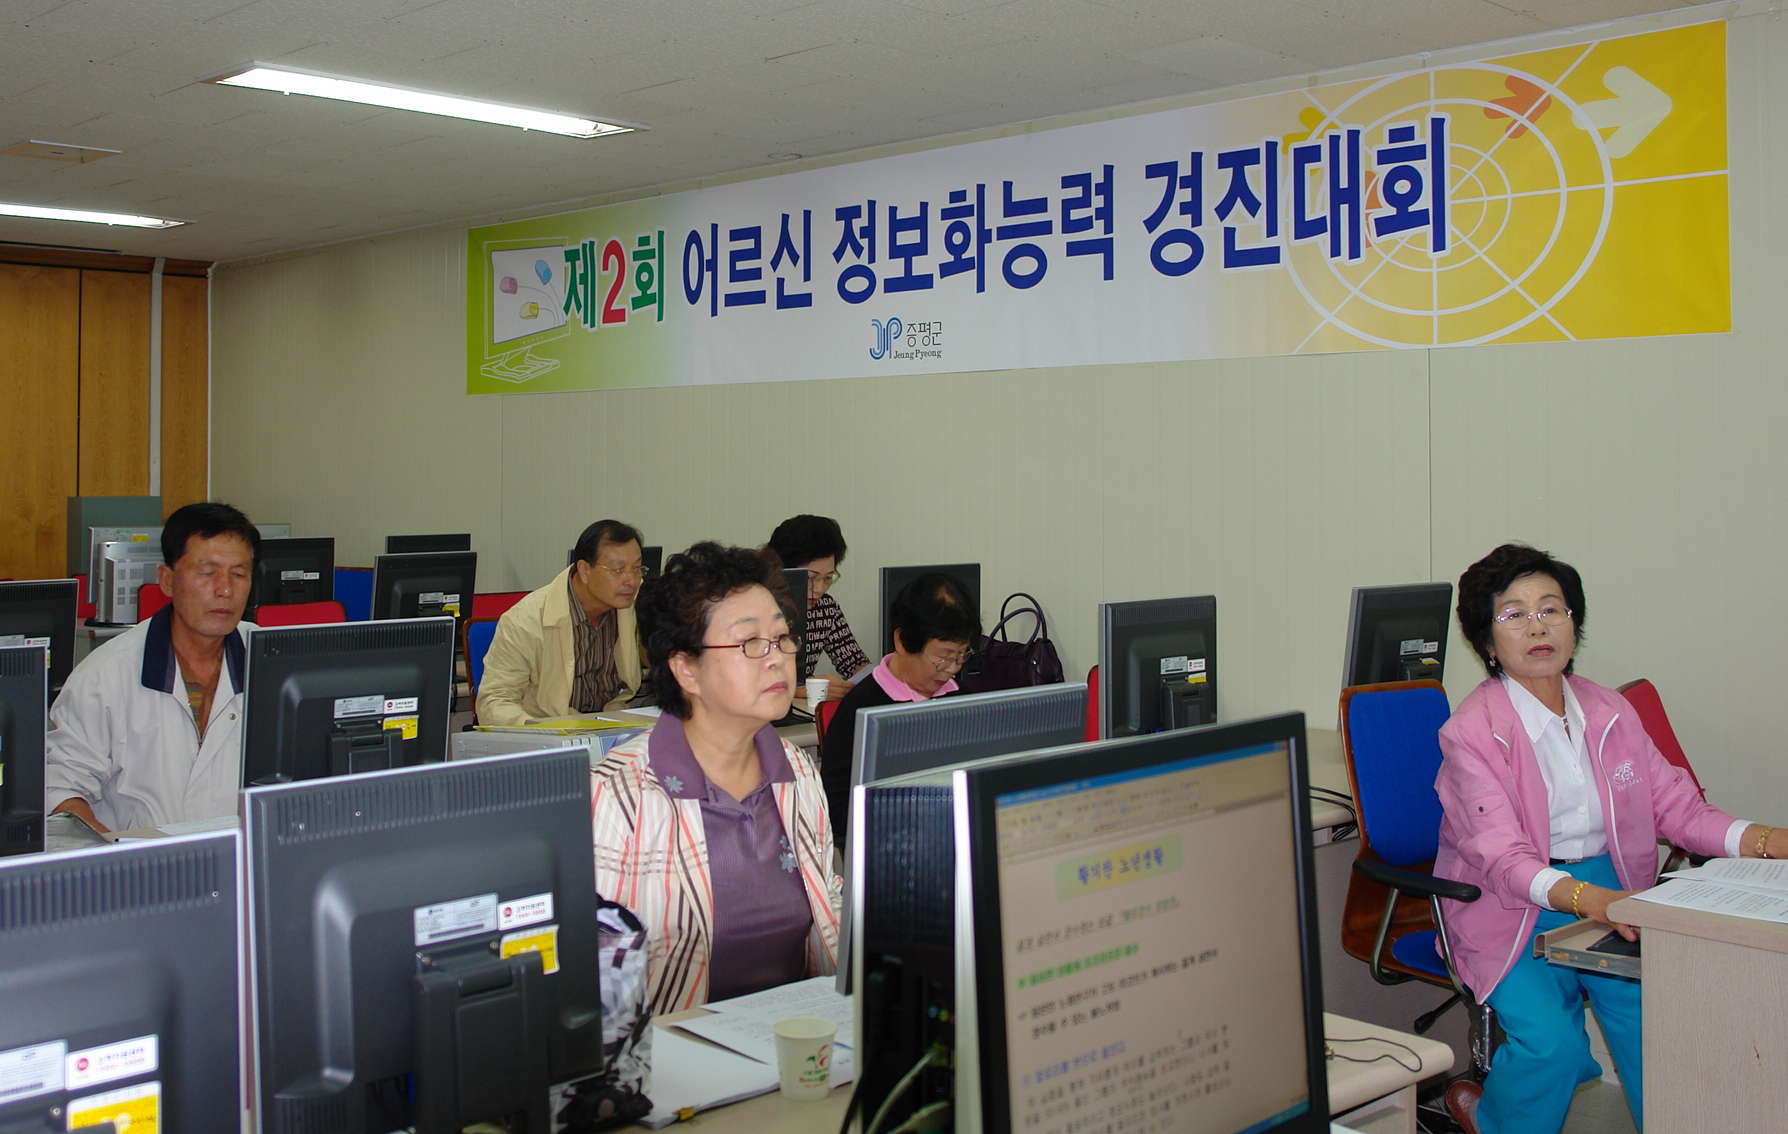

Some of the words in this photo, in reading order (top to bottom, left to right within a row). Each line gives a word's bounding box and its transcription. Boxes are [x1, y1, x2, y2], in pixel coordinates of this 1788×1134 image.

[563, 230, 665, 328] 제2회
[683, 209, 812, 317] 어르신
[832, 164, 1114, 304] 정보화능력
[1142, 117, 1446, 277] 경진대회
[907, 322, 942, 347] 증평군
